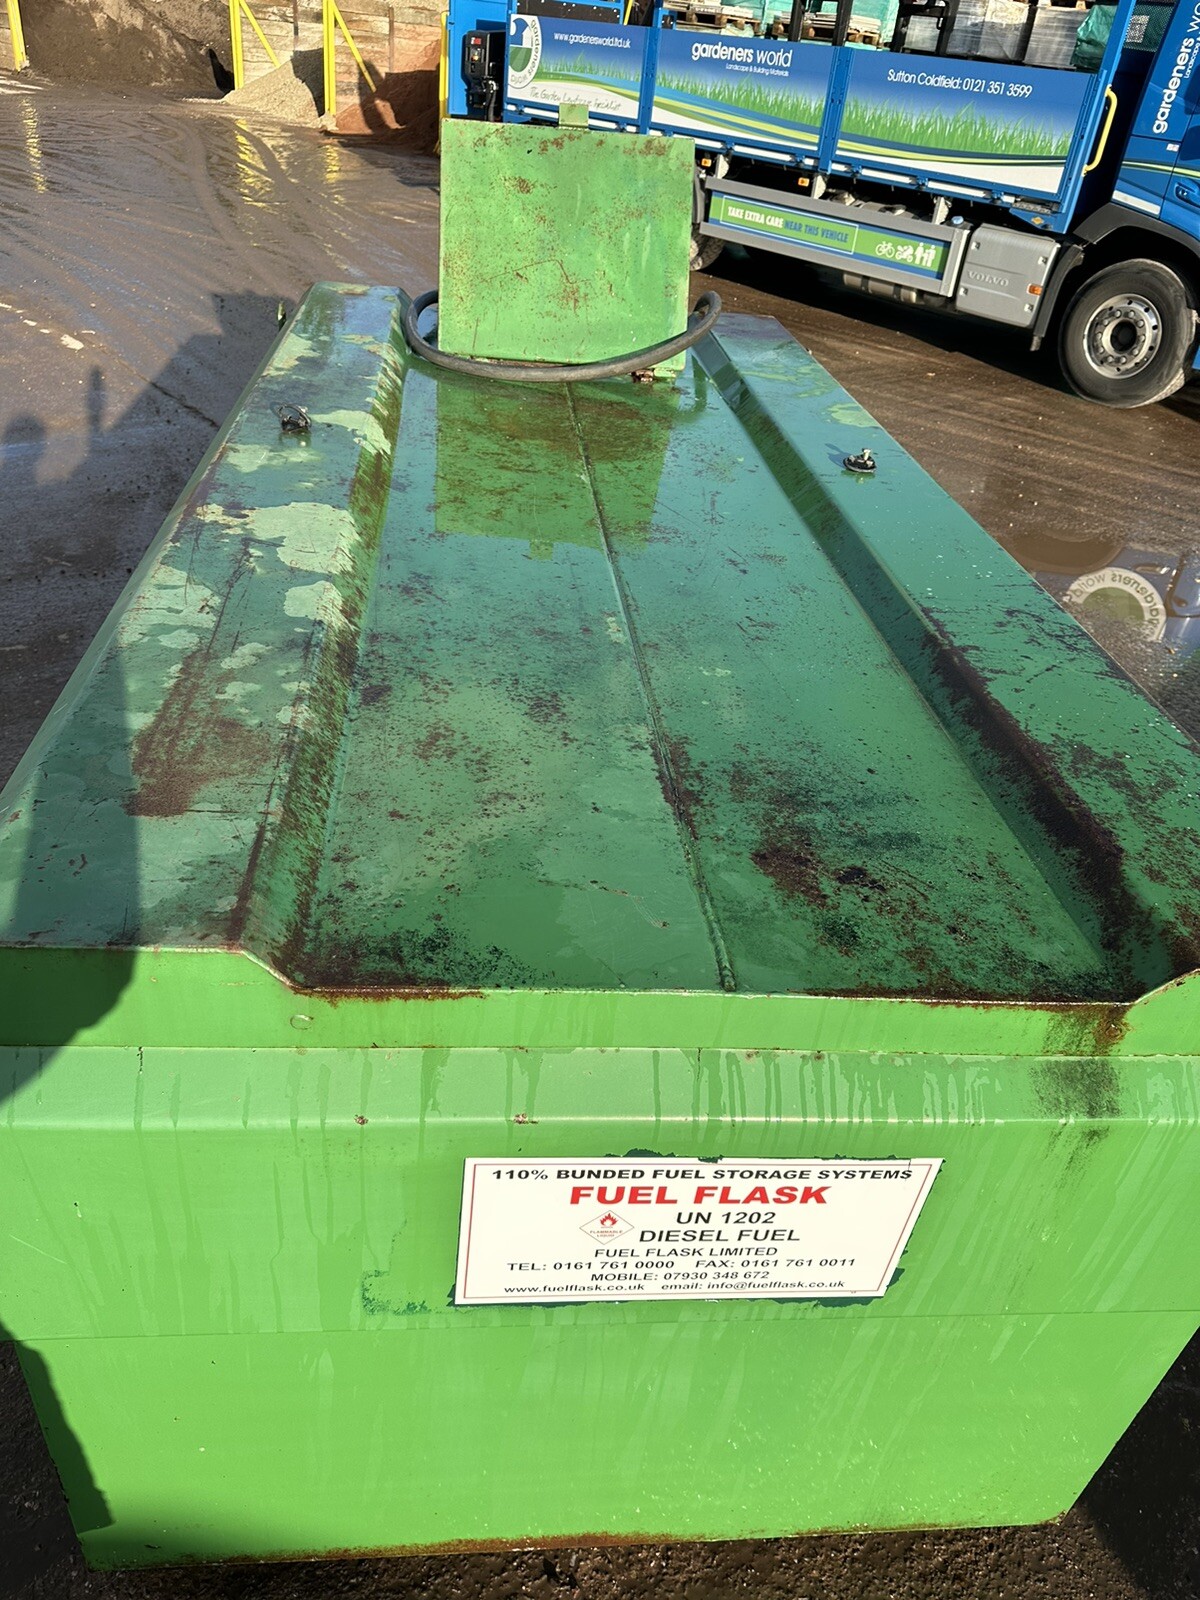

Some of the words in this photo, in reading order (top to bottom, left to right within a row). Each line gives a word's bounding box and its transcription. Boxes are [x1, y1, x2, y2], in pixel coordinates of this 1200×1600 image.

[691, 41, 754, 63] gardeners
[756, 48, 793, 68] world
[887, 68, 916, 84] Sutton
[917, 72, 962, 89] Coldfield:
[962, 77, 985, 93] 0121
[987, 80, 1005, 95] 351
[1006, 83, 1033, 98] 3599
[1152, 37, 1195, 134] gardeners
[727, 206, 744, 219] TAKE
[744, 210, 765, 225] EXTRA
[765, 215, 784, 229] CARE
[784, 220, 803, 233] NEAR
[804, 224, 819, 236] THIS
[820, 228, 849, 243] VEHICLE
[967, 270, 1009, 287] VOLVO
[492, 1169, 549, 1180] 110%
[556, 1169, 645, 1179] BUNDED
[652, 1169, 705, 1179] FUEL
[712, 1169, 811, 1179] STORAGE
[817, 1169, 913, 1180] SYSTEMS
[569, 1186, 678, 1205] FUEL
[693, 1186, 832, 1204] FLASK
[676, 1211, 712, 1225] UN
[721, 1211, 776, 1225] 1202
[639, 1230, 729, 1242] DIESEL
[737, 1229, 801, 1242] FUEL
[594, 1248, 640, 1258] FUEL
[645, 1248, 704, 1257] FLASK
[709, 1247, 778, 1256] LIMITED
[506, 1262, 547, 1271] TEL:
[553, 1261, 593, 1270] 0161
[600, 1261, 628, 1270] 761
[635, 1260, 675, 1269] 0000
[695, 1260, 735, 1268] FAX:
[741, 1259, 779, 1267] 0161
[786, 1259, 813, 1267] 761
[819, 1258, 856, 1267] 0011
[590, 1273, 658, 1281] MOBILE:
[663, 1272, 708, 1280] 07930
[712, 1271, 739, 1280] 348
[743, 1271, 770, 1279] 672
[504, 1283, 645, 1293] www.fuelflask.co.uk
[661, 1281, 703, 1291] email:
[707, 1280, 846, 1291] info@fuelflask.co.uk
